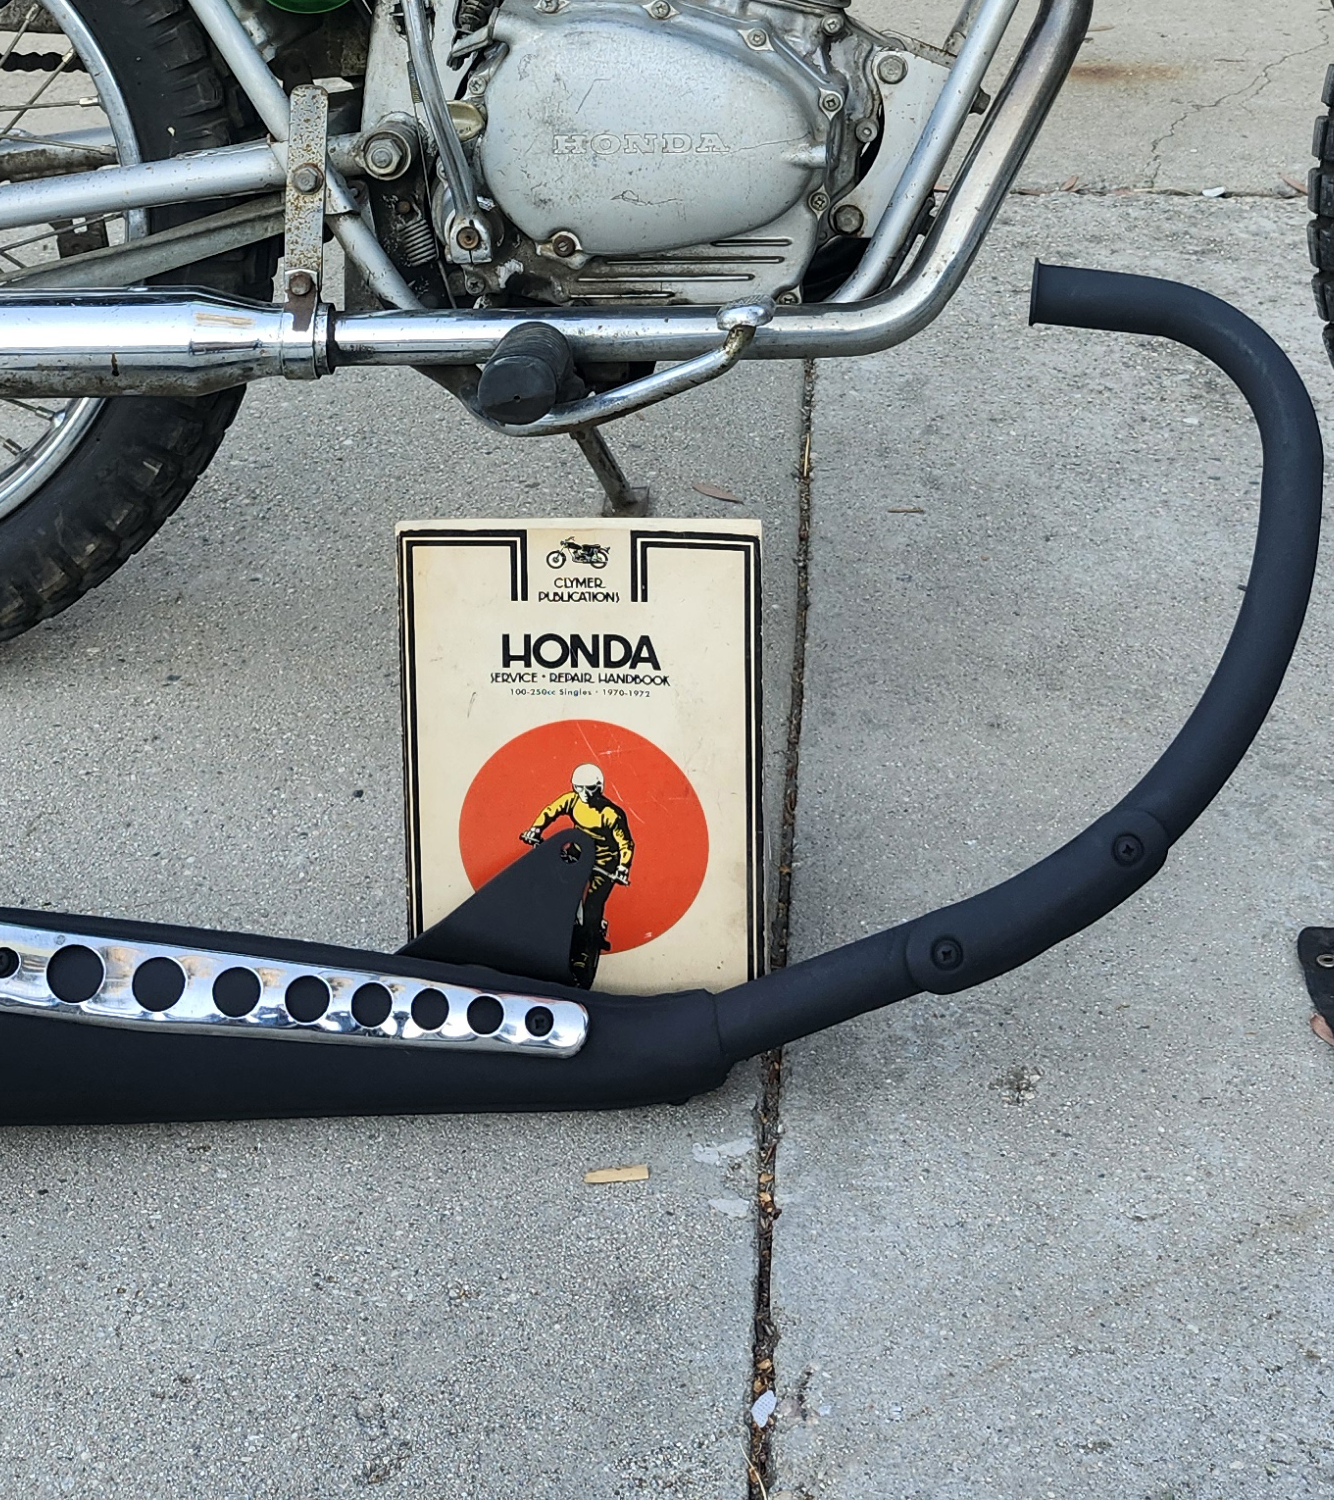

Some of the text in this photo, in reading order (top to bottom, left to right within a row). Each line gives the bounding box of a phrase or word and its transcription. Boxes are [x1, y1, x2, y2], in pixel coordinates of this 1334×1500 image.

[552, 132, 731, 156] HONDA
[554, 577, 606, 589] CLYMER
[538, 591, 620, 603] PUBLICATIONS
[502, 633, 661, 671] HONDA
[490, 672, 671, 686] SERVICE REPAIR HANDBOOK
[559, 688, 592, 697] Singles
[603, 688, 651, 698] 1970-1972
